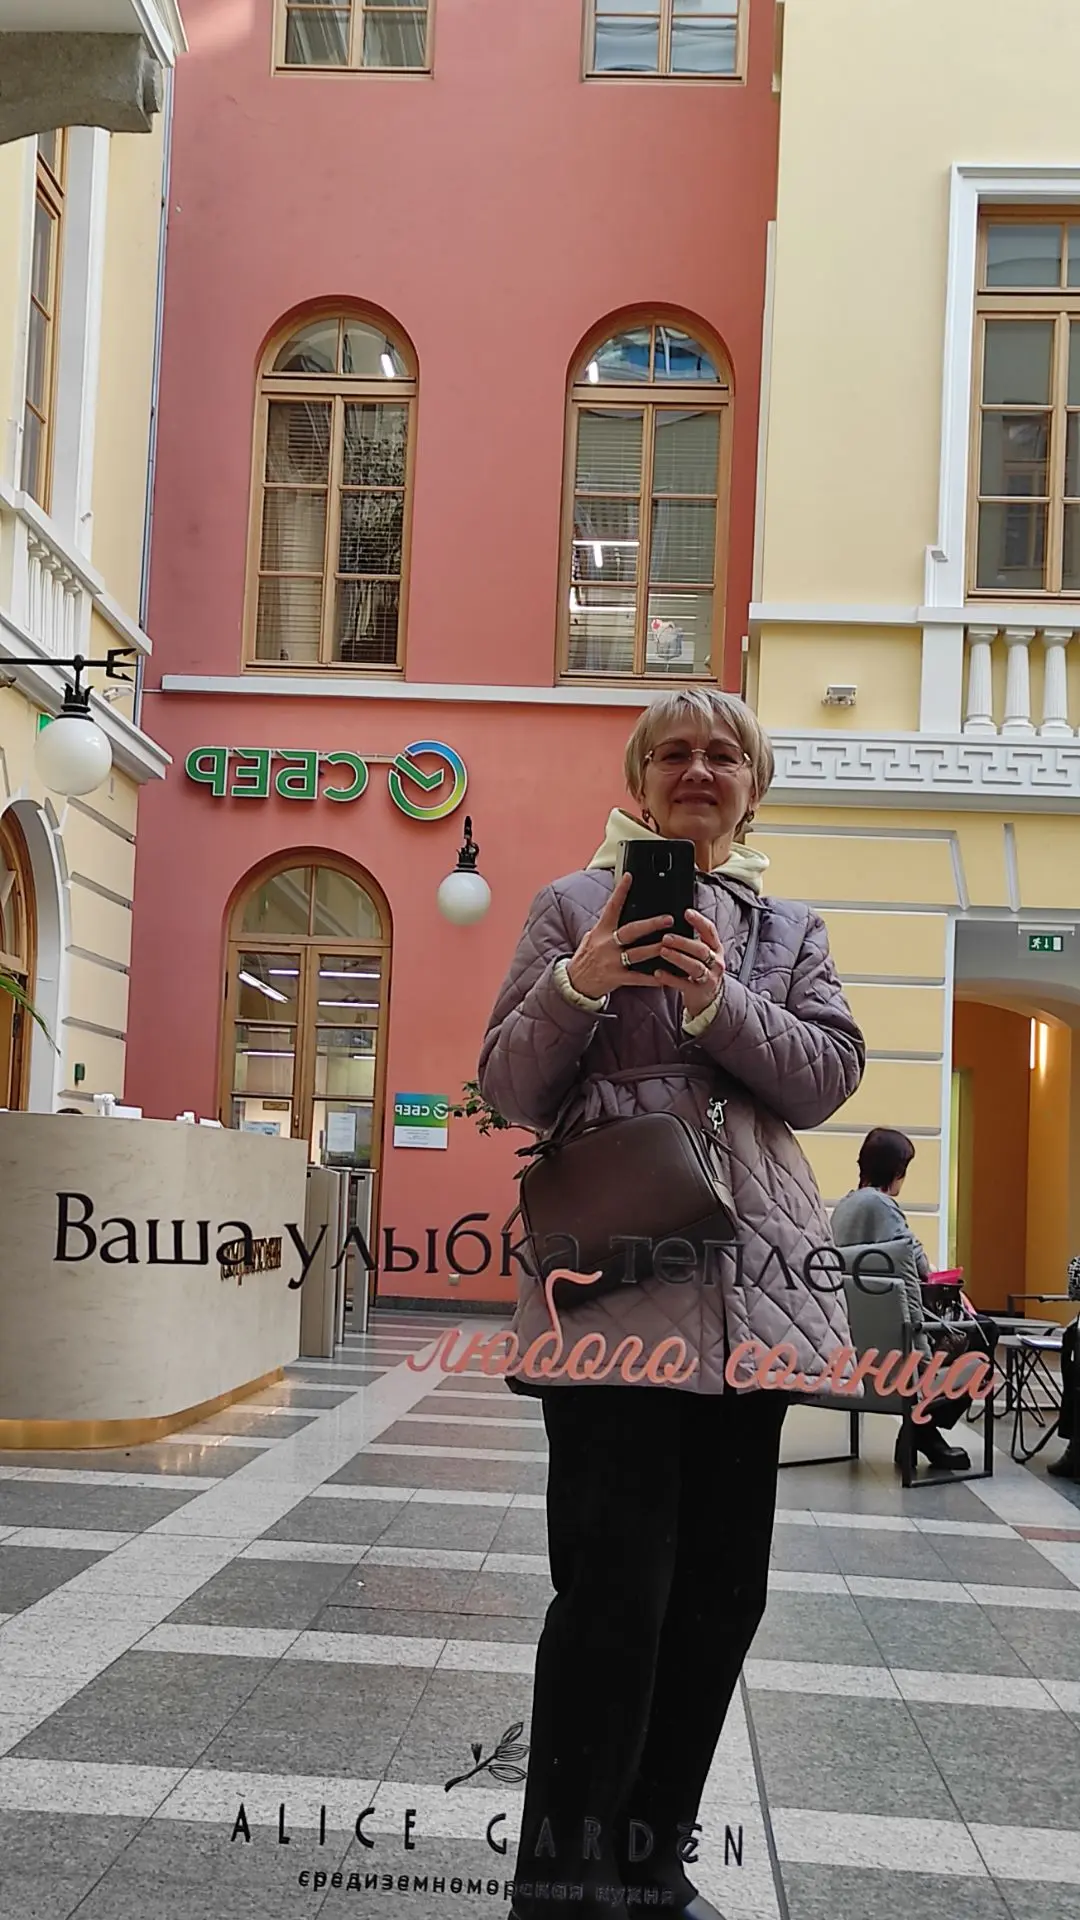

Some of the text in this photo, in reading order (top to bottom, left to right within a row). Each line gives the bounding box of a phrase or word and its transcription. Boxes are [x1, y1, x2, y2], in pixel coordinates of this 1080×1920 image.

[53, 1191, 254, 1266] Ваша
[284, 1212, 580, 1290] улыбка
[608, 1234, 899, 1295] теплее
[407, 1268, 1000, 1425] любого солнца
[230, 1803, 417, 1851] ALICE
[298, 1869, 584, 1901] средиземноморская
